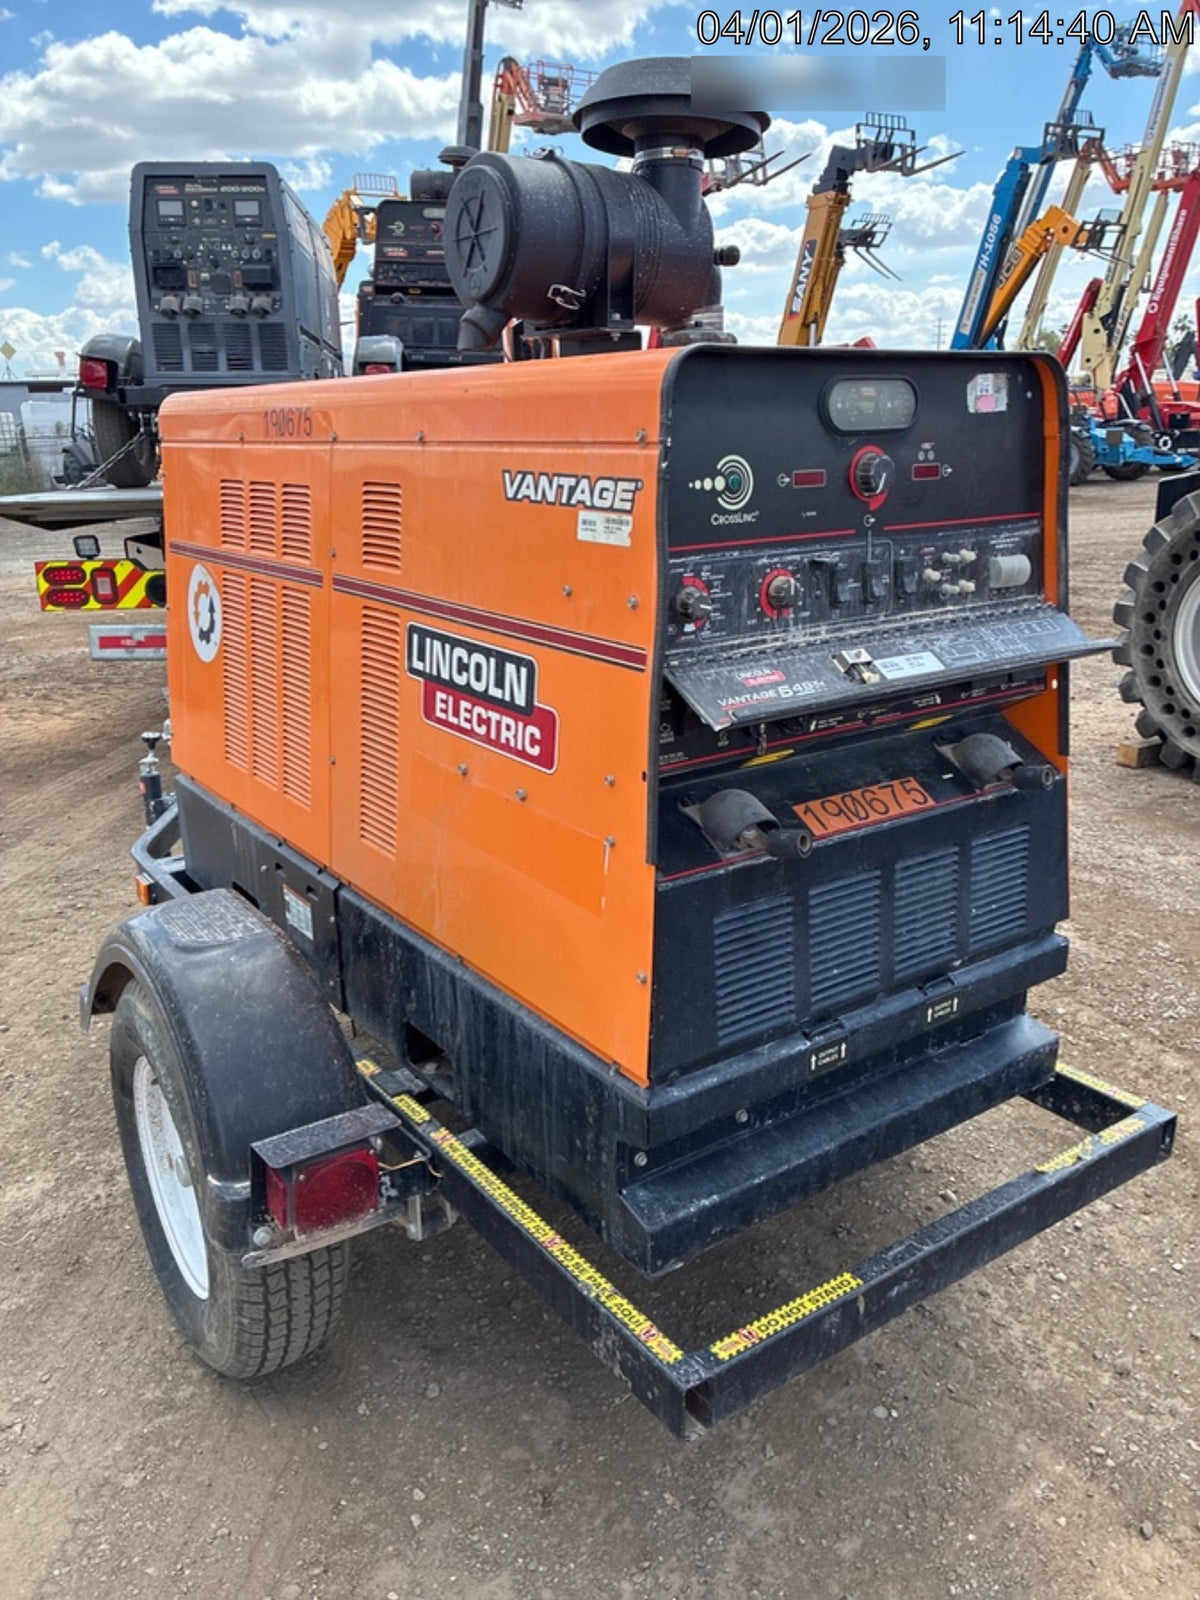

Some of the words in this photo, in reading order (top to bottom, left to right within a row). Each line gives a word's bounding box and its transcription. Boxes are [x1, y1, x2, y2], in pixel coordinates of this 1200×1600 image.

[792, 249, 814, 314] SANY
[996, 247, 1024, 290] JCB
[263, 407, 312, 438] 190675
[503, 470, 637, 512] VANTAGE
[411, 632, 527, 708] LINCOLN
[717, 689, 778, 707] VANTAGE
[435, 690, 542, 758] ELECTRIC
[802, 778, 929, 831] 190675
[498, 1190, 535, 1225] DEBOUT
[559, 1247, 575, 1261] NO
[572, 1261, 589, 1276] SE
[757, 1318, 780, 1333] DO
[780, 1302, 808, 1321] NOT
